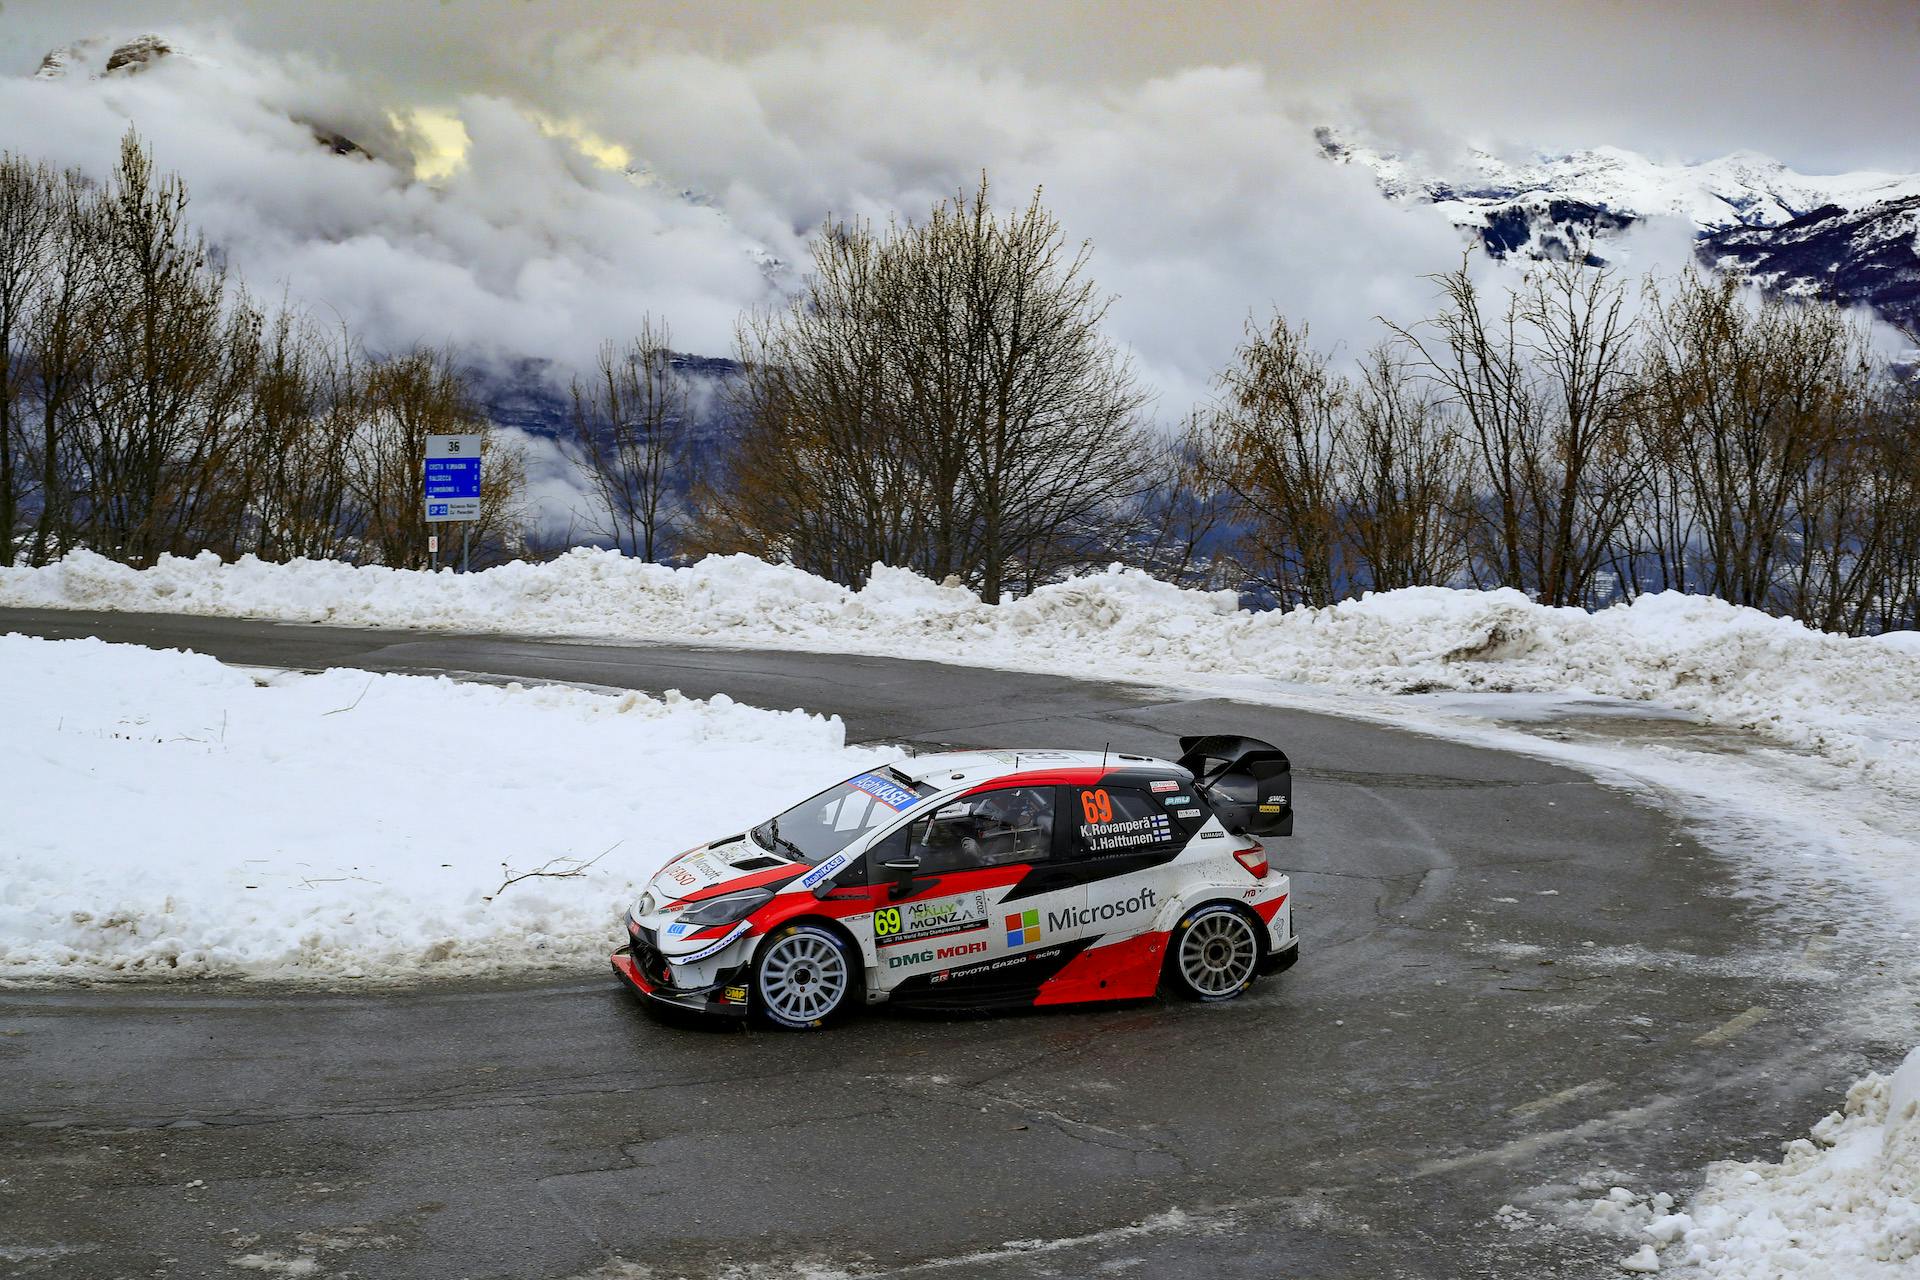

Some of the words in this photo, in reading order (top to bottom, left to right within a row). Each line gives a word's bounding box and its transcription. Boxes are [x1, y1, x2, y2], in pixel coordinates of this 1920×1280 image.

[448, 441, 460, 452] 36
[430, 505, 438, 514] SP
[439, 505, 447, 514] 22
[1081, 789, 1112, 823] 69
[1080, 816, 1151, 837] K.Rovanperä
[1090, 832, 1154, 851] J.Halttunen
[803, 855, 845, 888] AsahiKASEI
[914, 903, 955, 919] RALLY
[975, 895, 986, 915] 2020
[1048, 887, 1157, 933] Microsoft
[874, 908, 901, 936] 69
[910, 909, 974, 930] MONZA
[682, 928, 746, 963] Panasonic
[889, 950, 934, 969] DMG
[936, 941, 987, 960] MORI
[951, 965, 990, 978] TOYOTA
[991, 957, 1027, 970] GAZOO
[1028, 949, 1061, 962] Racing
[725, 988, 745, 999] OMP
